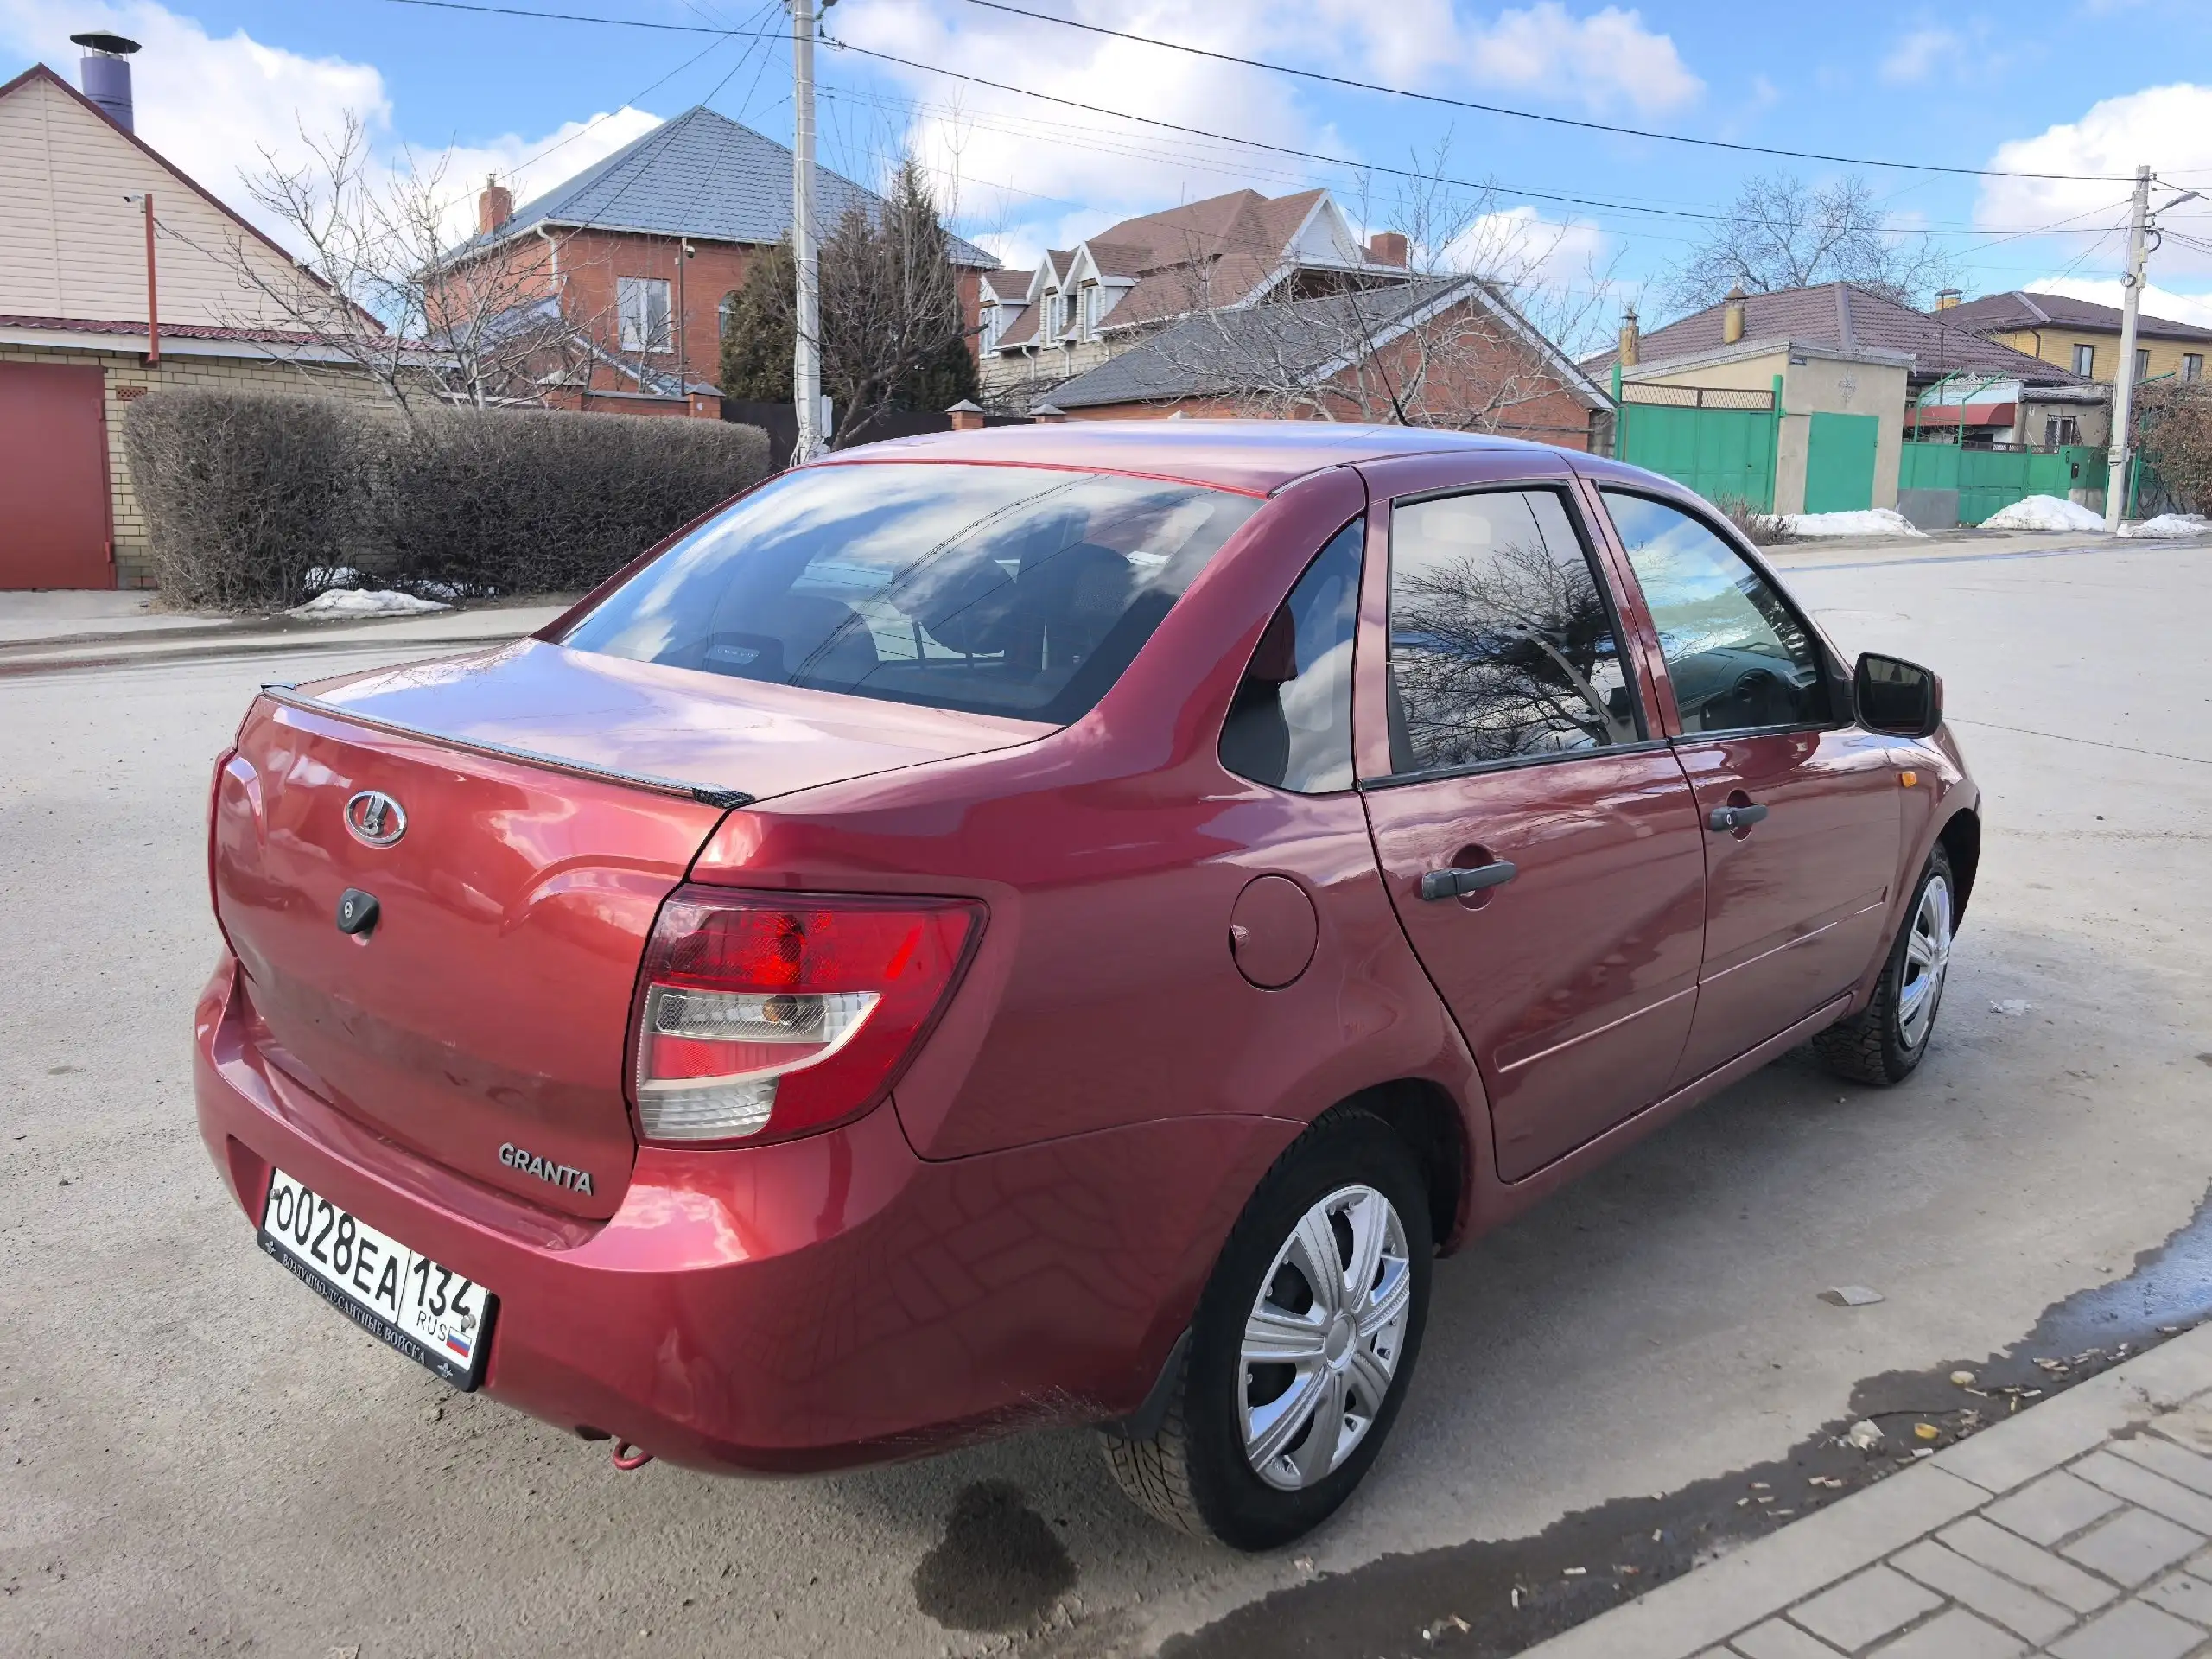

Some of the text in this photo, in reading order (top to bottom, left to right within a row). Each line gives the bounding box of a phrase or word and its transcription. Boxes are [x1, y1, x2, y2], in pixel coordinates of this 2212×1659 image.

[499, 1141, 593, 1197] GRANTA
[283, 1253, 425, 1364] ВОЗДУШНО-ДЕСАНТНЫЕ ВОЙСКА
[413, 1257, 473, 1333] 134
[416, 1310, 448, 1342] RUS
